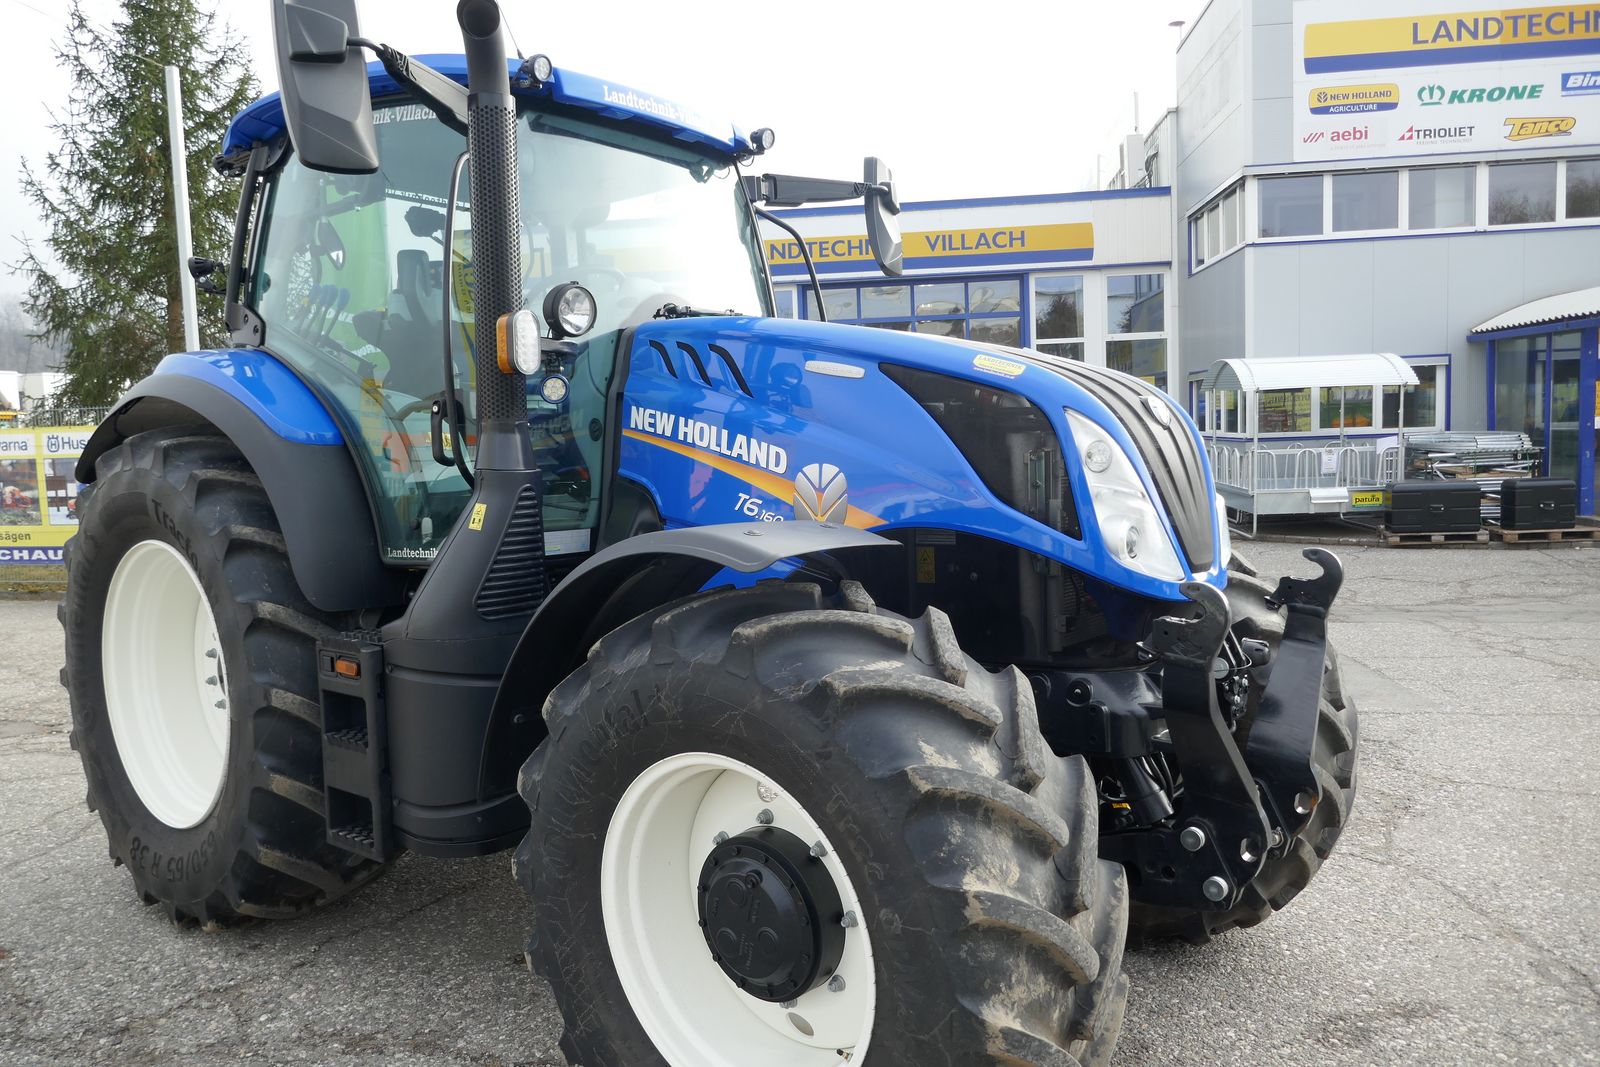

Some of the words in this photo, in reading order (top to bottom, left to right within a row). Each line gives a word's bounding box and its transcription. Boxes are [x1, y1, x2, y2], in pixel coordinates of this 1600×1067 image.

[1412, 10, 1600, 45] LANDTECH
[1330, 93, 1350, 101] NEW
[1352, 90, 1392, 100] HOLLAND
[1447, 84, 1544, 105] KRONE
[1329, 103, 1378, 113] AGRICULTURE
[1330, 126, 1369, 142] aebi
[1414, 126, 1475, 140] TRIOLIET
[1504, 117, 1577, 141] Tanco
[924, 230, 1025, 252] VILLACH
[0, 440, 28, 452] arna
[630, 405, 676, 437] NEW
[677, 416, 788, 475] HOLLAND
[387, 547, 439, 558] Landtechnik
